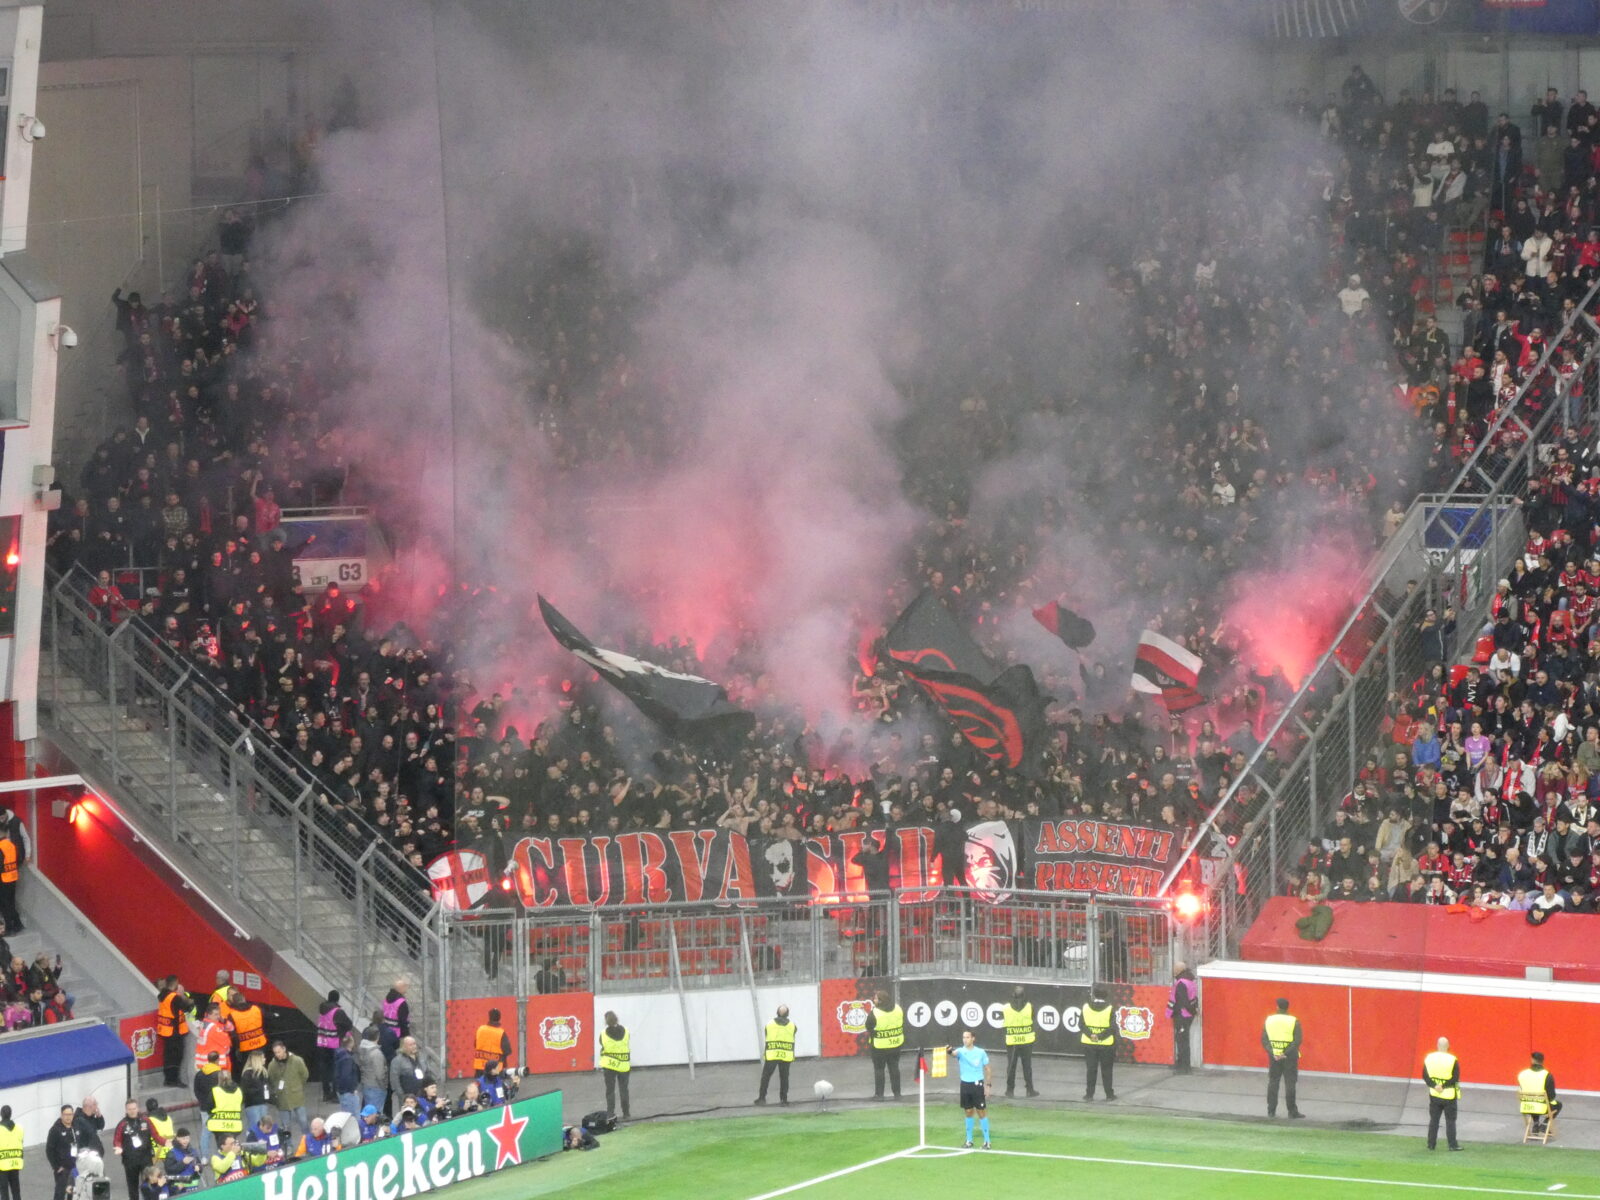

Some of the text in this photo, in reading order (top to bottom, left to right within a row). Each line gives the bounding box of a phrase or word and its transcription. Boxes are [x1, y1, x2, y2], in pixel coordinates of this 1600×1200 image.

[339, 562, 362, 581] G3
[1036, 819, 1174, 863] ASSENTI
[512, 828, 759, 912] CURVA
[1034, 860, 1165, 899] PRESENTI
[262, 1129, 485, 1200] Heineken
